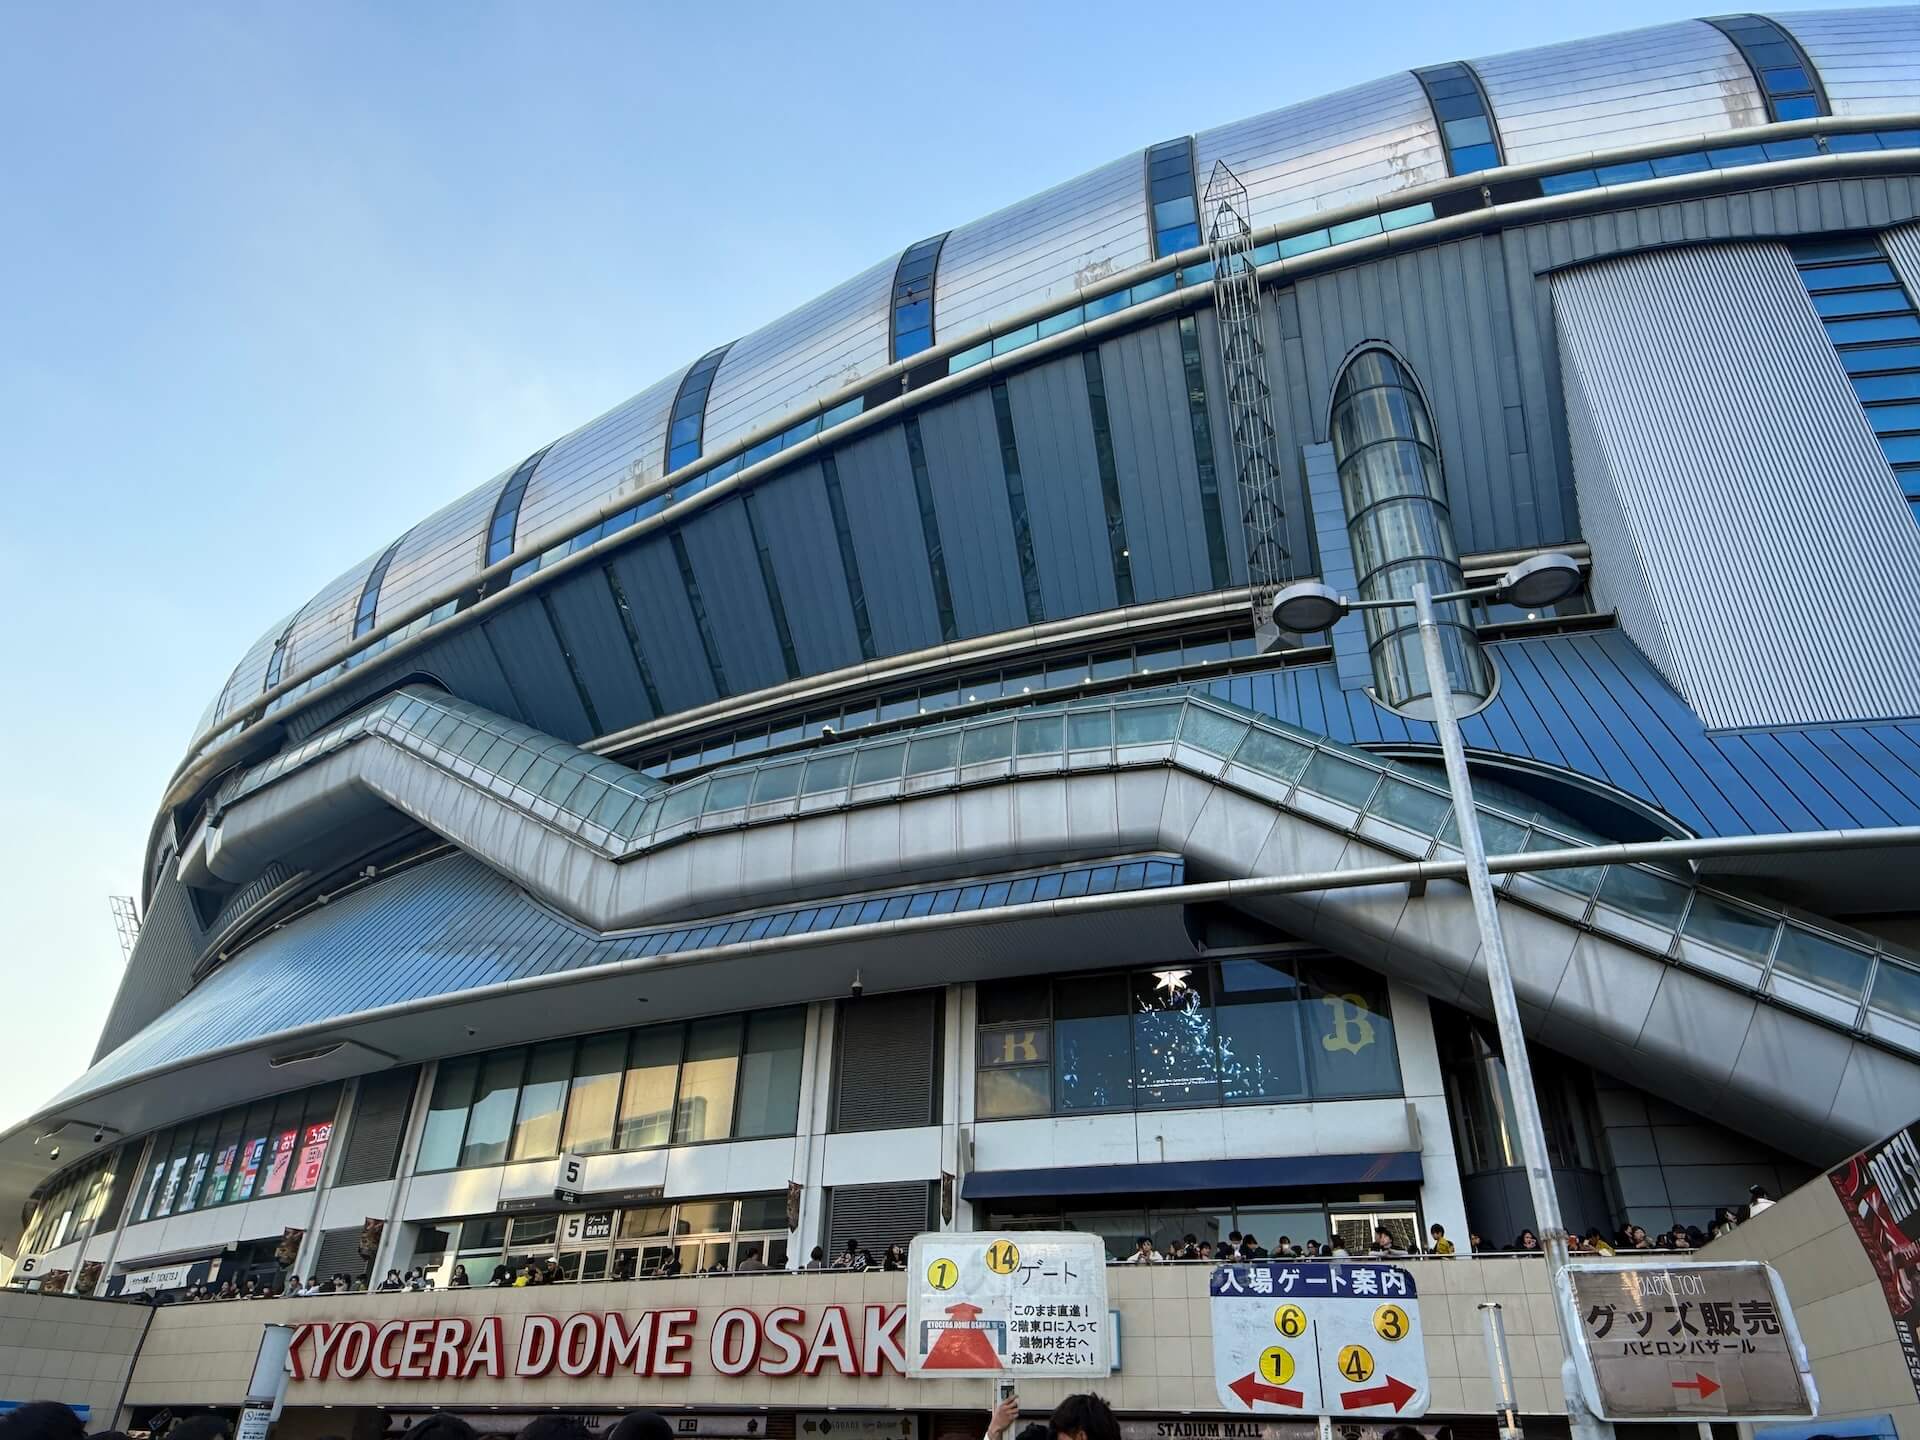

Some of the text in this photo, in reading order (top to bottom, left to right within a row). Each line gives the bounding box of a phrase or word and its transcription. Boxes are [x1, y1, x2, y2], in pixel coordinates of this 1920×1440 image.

[567, 1161, 580, 1183] 5
[568, 1219, 580, 1238] 5
[587, 1214, 607, 1224] ゲート
[586, 1225, 609, 1237] GATE
[23, 1258, 36, 1272] 6
[990, 1246, 1014, 1270] 14
[1017, 1260, 1078, 1286] ゲート
[1220, 1267, 1406, 1295] 入場ゲート案内
[1586, 1300, 1780, 1339] グッズ販売
[284, 1305, 907, 1379] KYOCERA DOME OSAK
[1018, 1336, 1089, 1349] 建物内を右へ
[1157, 1422, 1263, 1438] STADIUM MALL
